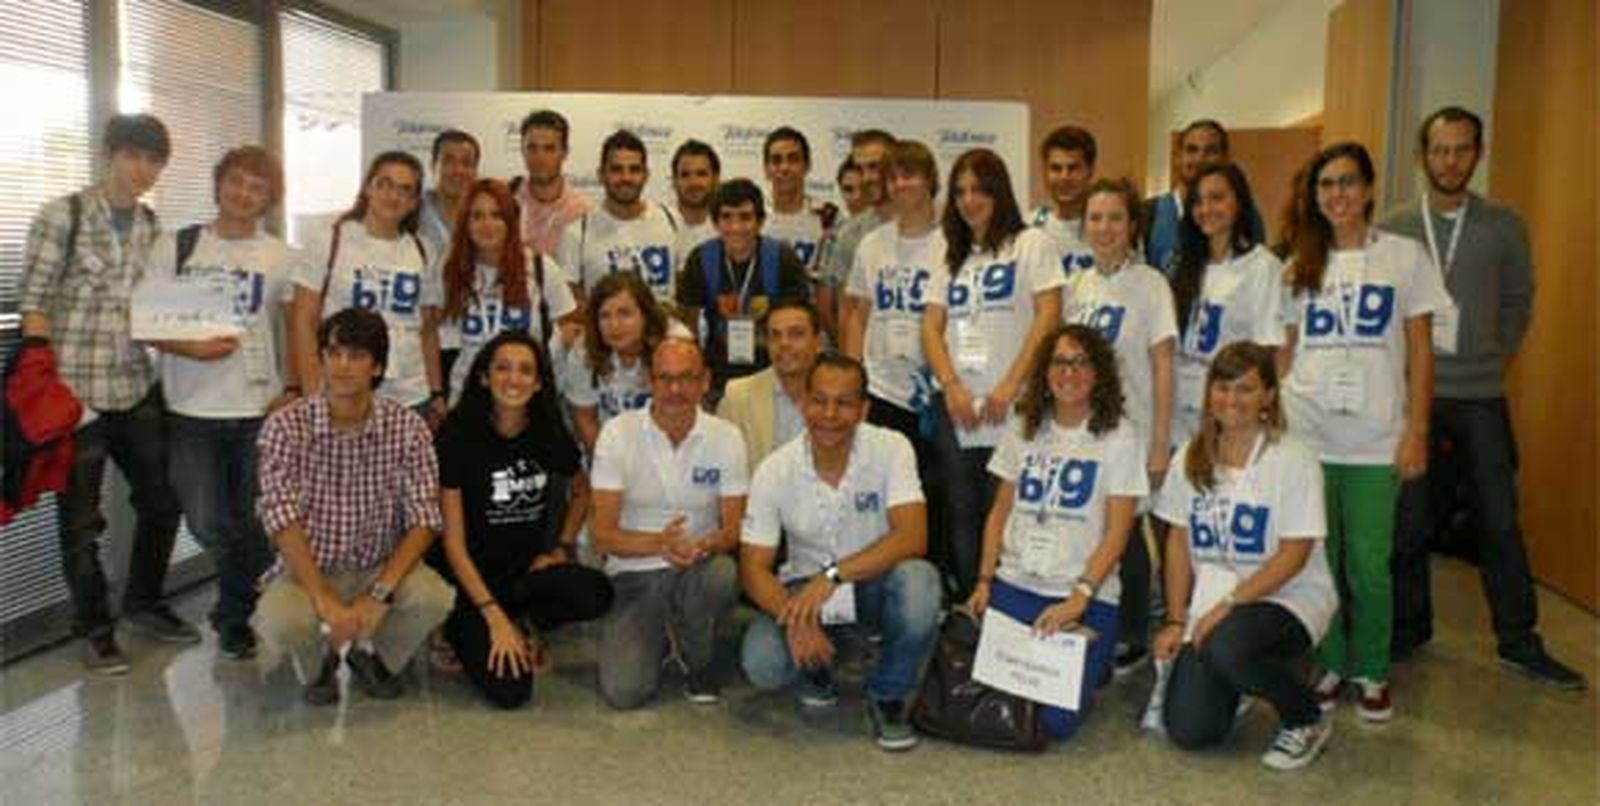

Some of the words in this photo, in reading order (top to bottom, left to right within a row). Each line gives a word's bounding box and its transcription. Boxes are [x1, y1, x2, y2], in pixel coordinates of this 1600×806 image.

[353, 271, 420, 315] big
[1305, 284, 1395, 337] big
[1018, 458, 1098, 509] big
[1190, 503, 1269, 553] big
